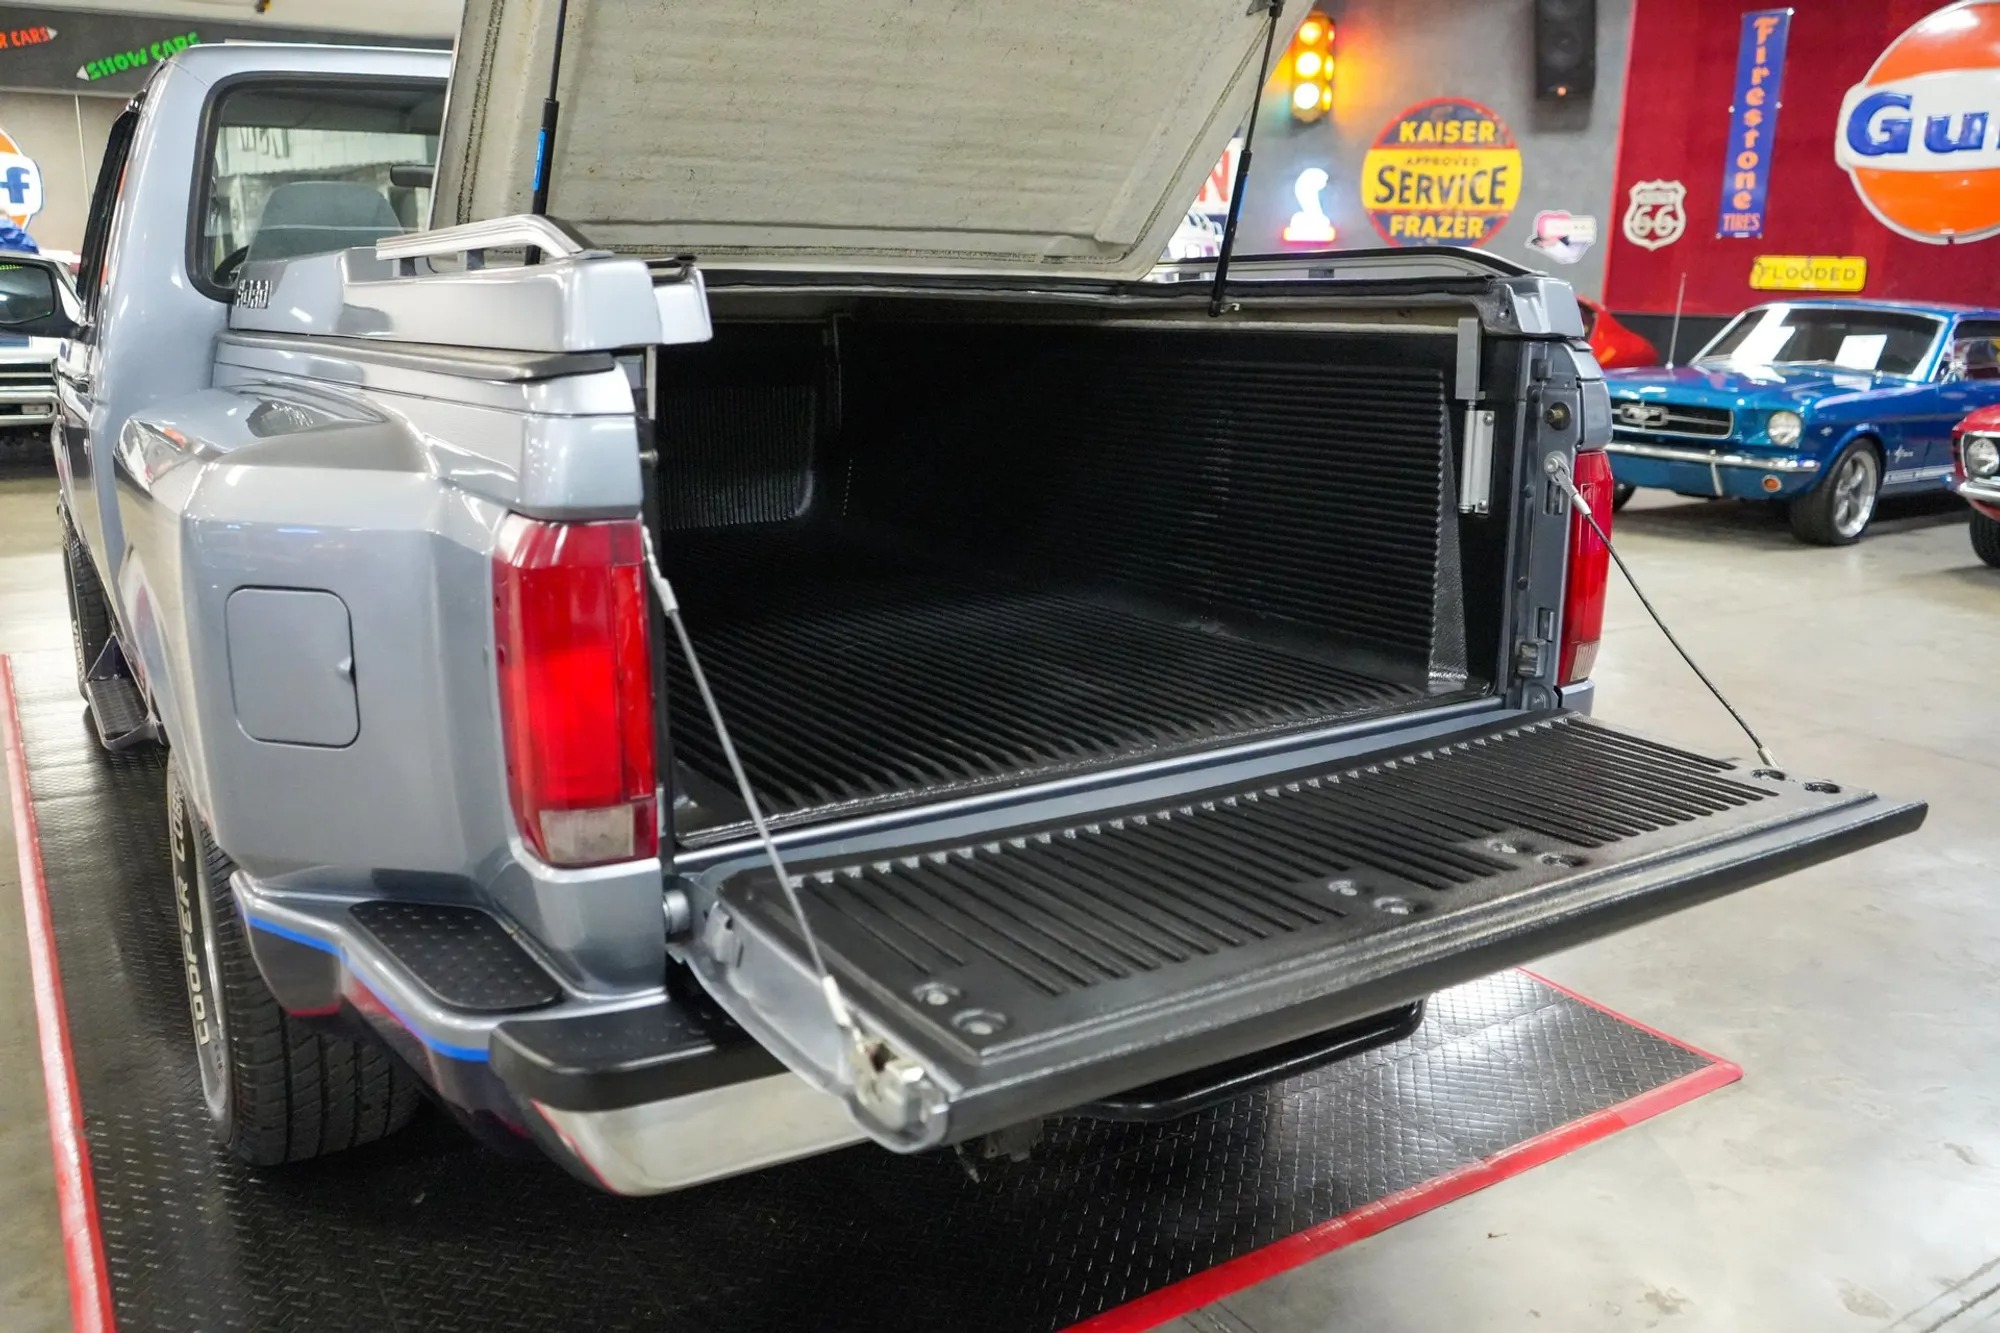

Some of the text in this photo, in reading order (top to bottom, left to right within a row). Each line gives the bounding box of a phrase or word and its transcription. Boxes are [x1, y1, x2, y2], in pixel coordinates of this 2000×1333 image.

[11, 26, 50, 47] CARS
[86, 47, 148, 81] SHOW
[1732, 16, 1779, 210] Firestone
[1847, 91, 2000, 156] Gu
[1399, 119, 1496, 144] KAISER
[1405, 155, 1480, 166] APPROVED
[1375, 165, 1508, 205] SERVICE
[1389, 214, 1485, 239] FRAZER
[1631, 204, 1676, 237] 66
[1722, 213, 1761, 231] TIRES
[177, 875, 210, 1046] COOPER
